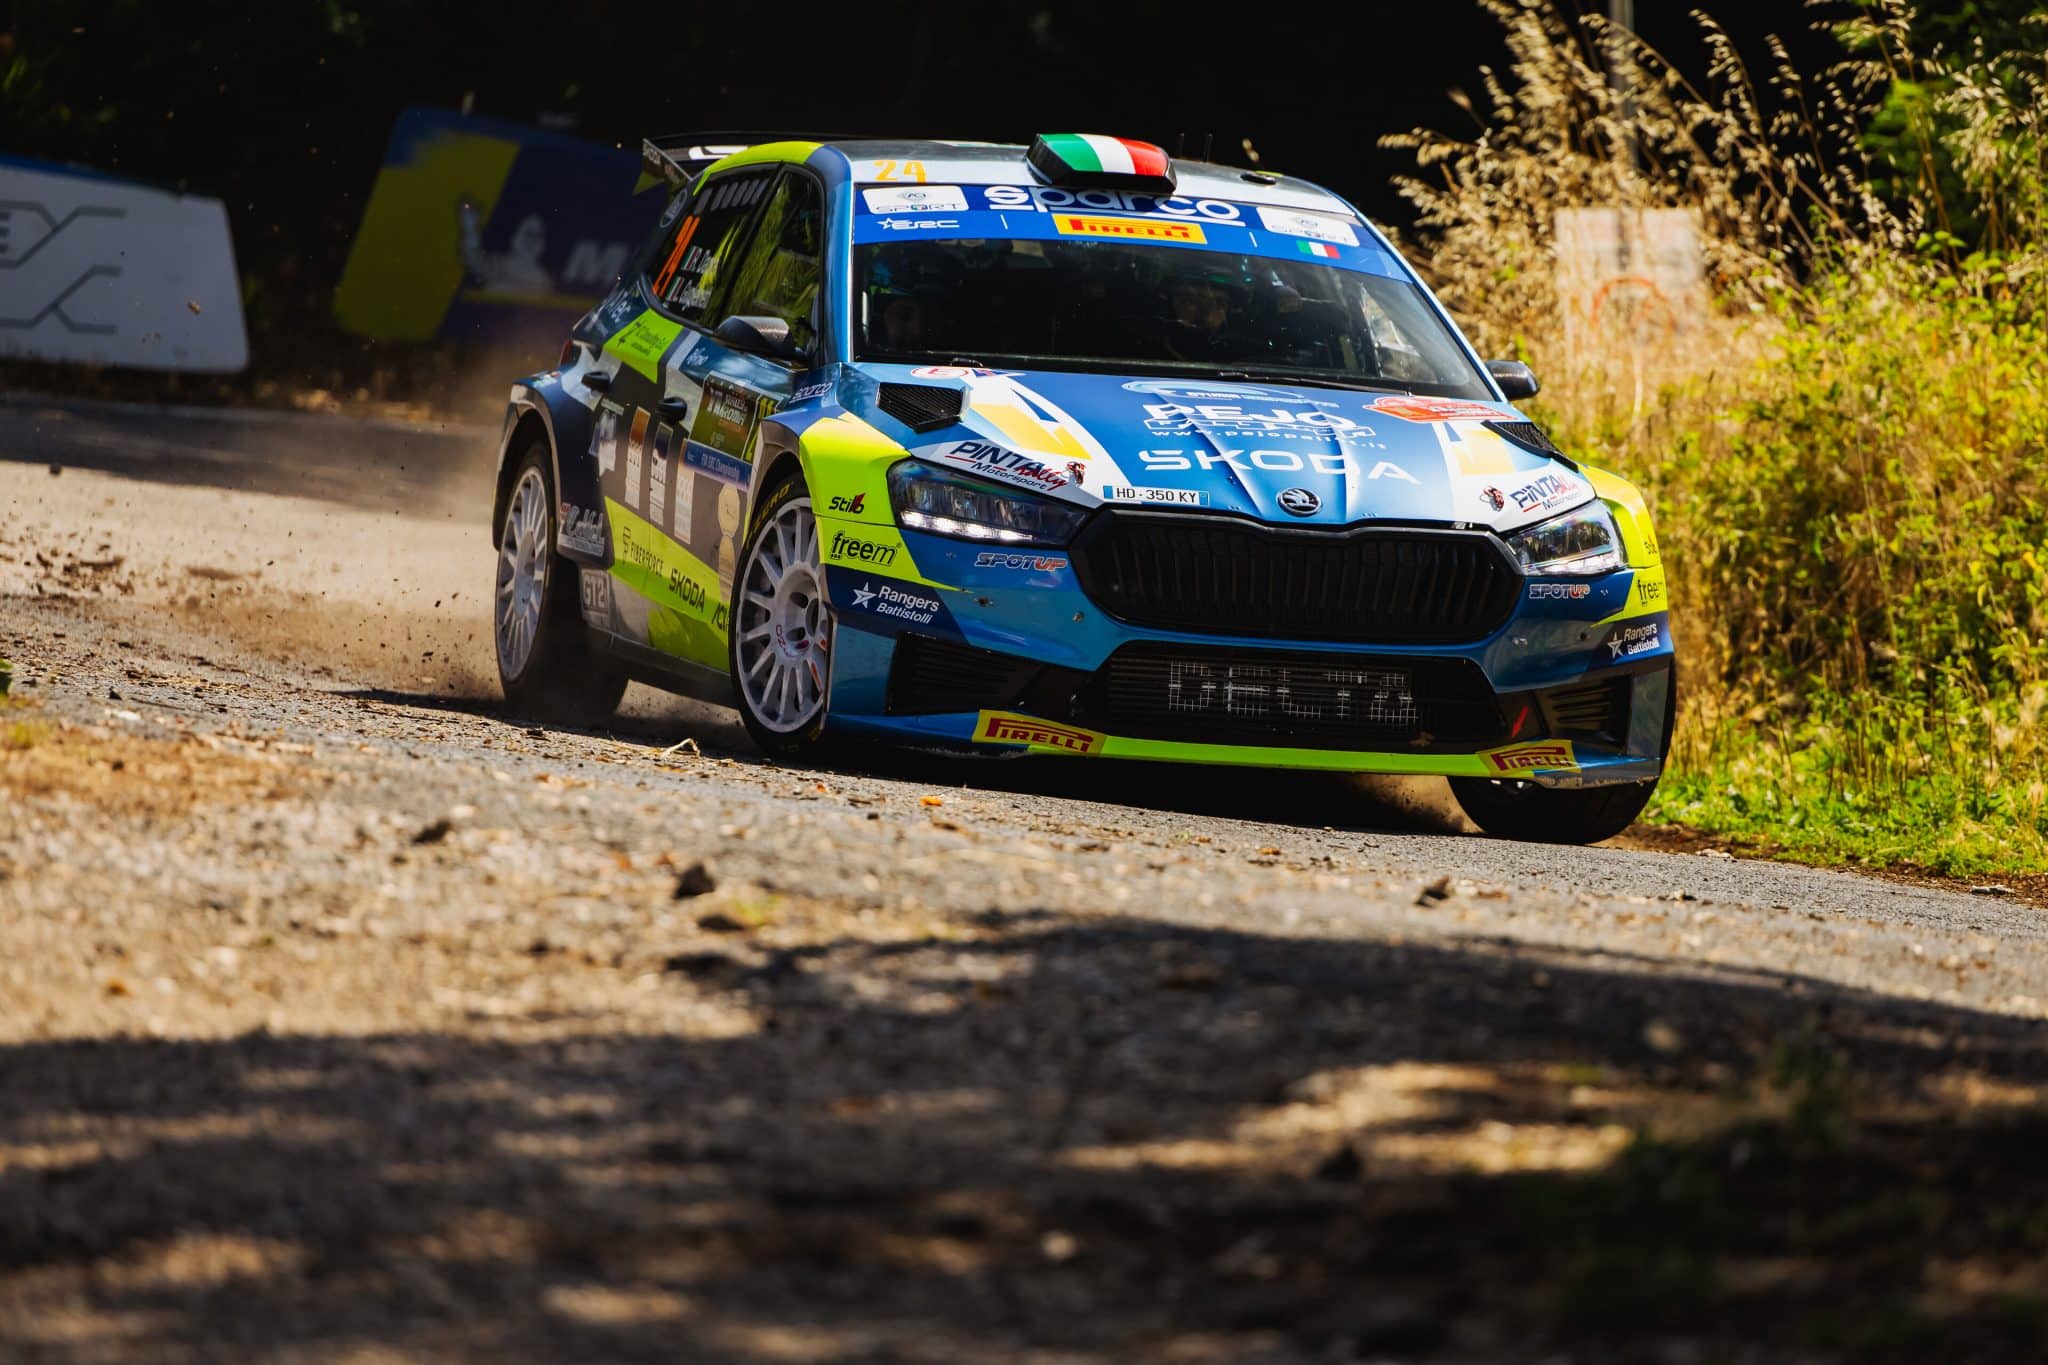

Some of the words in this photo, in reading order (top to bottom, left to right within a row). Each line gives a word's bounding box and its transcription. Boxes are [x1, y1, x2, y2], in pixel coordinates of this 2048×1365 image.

[984, 186, 1241, 222] sparco
[1069, 218, 1190, 239] PIRELLI
[971, 462, 1048, 490] Motorsport
[1139, 449, 1420, 486] SKODA
[828, 492, 866, 514] Stilo
[1116, 487, 1136, 499] HD
[1145, 489, 1175, 502] 350
[1179, 491, 1197, 504] KY
[832, 530, 897, 567] freem
[974, 552, 1068, 572] SPOTUP
[879, 584, 940, 612] Rangers
[1529, 584, 1591, 600] SPOTUP
[876, 602, 933, 625] Battistolli
[1624, 623, 1658, 641] Rangers
[1168, 659, 1418, 723] DELTA
[985, 717, 1094, 753] PIRELLI
[1491, 746, 1574, 771] PIRELLI
